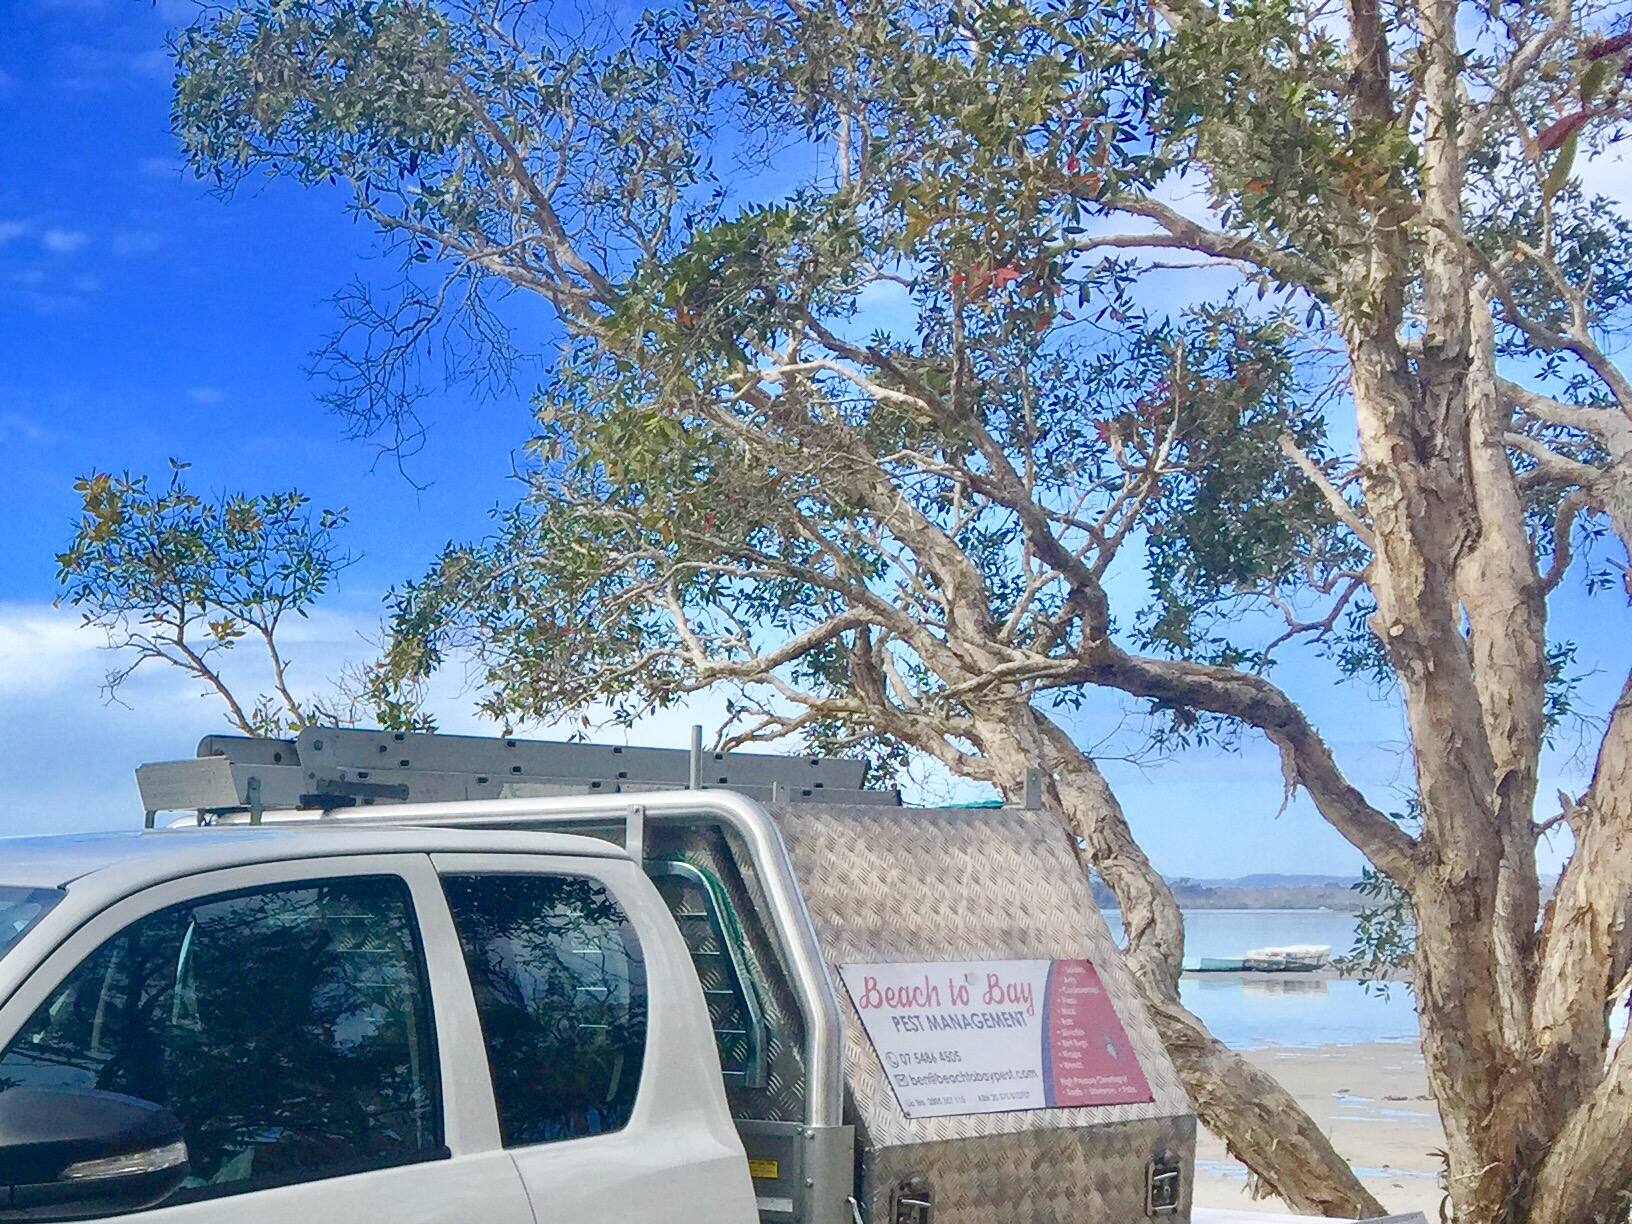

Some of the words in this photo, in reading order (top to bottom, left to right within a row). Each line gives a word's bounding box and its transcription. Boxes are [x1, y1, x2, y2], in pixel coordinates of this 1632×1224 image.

[859, 975, 941, 1009] Beach
[949, 978, 969, 1008] to
[983, 973, 1035, 1017] Bay
[891, 1013, 925, 1032] PEST
[927, 1011, 1027, 1030] MANAGEMENT
[900, 1053, 911, 1065] 07
[916, 1052, 937, 1065] 5486
[939, 1050, 962, 1063] 4505
